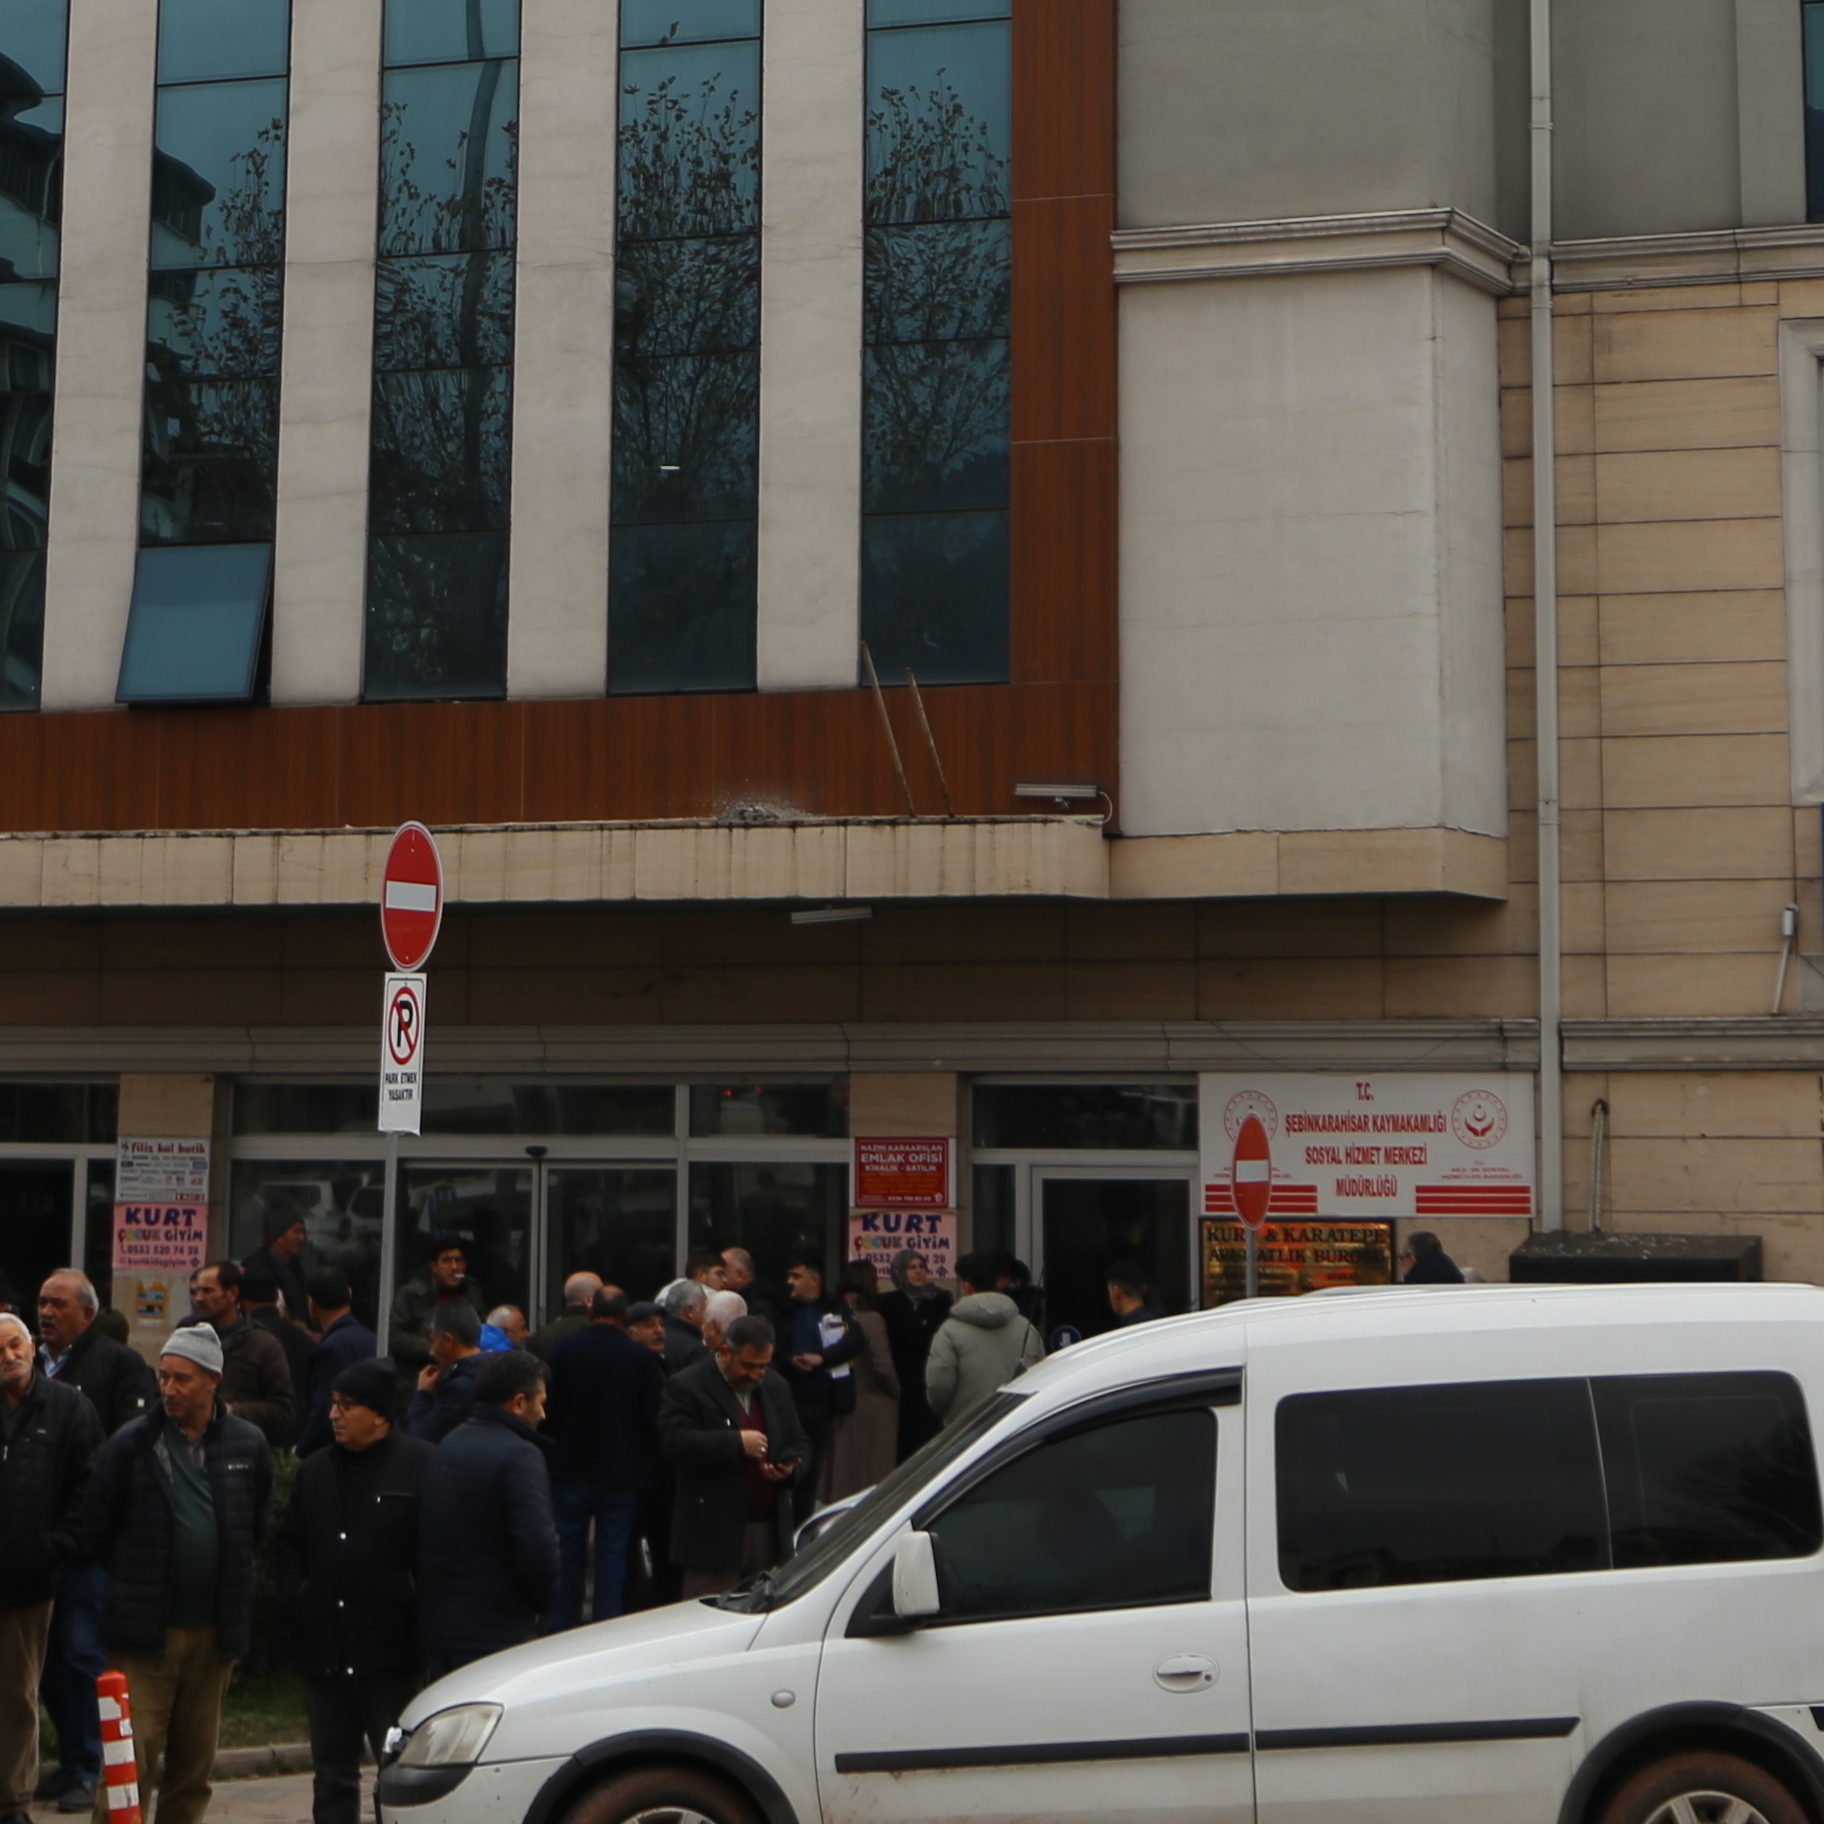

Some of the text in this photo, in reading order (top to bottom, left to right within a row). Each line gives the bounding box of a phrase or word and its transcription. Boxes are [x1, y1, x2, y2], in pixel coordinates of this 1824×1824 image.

[385, 1072, 417, 1084] PARK ETMEK
[1356, 1082, 1375, 1101] T.C.
[1285, 1109, 1448, 1137] ŞEBİNKARAHİSAR KAYMAKAMLIĞI
[861, 1150, 943, 1164] EMLAK OFİSİ
[1305, 1141, 1428, 1165] SOSYAL HİZMET MERKEZİ
[1336, 1174, 1398, 1198] MÜDÜRLÜĞÜ
[125, 1207, 197, 1226] KURT
[862, 1213, 942, 1234] KURT
[164, 1226, 203, 1241] GİYİM
[907, 1233, 950, 1250] GİYİM
[1206, 1228, 1249, 1243] KUR
[1283, 1228, 1388, 1243] KARATEPE
